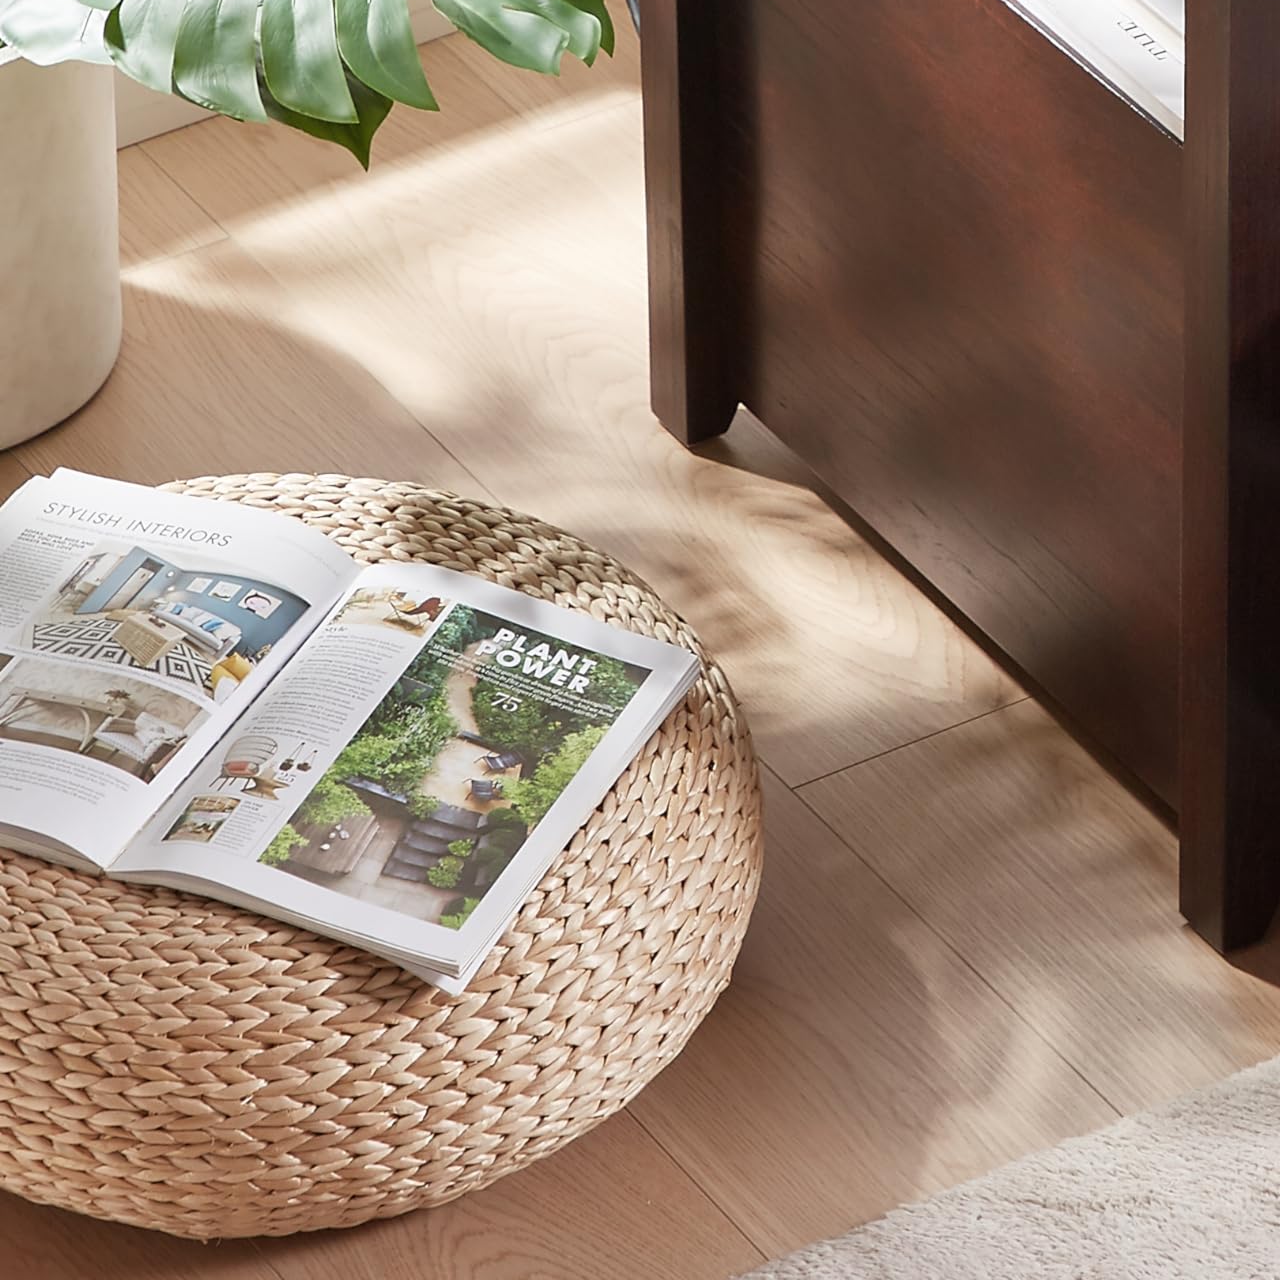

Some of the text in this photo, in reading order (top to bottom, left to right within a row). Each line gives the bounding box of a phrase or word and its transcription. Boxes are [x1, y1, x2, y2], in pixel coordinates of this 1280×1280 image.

[43, 502, 123, 527] STYLISH
[126, 519, 232, 548] INTERIORS
[475, 640, 590, 694] POWER
[493, 628, 597, 675] PLANT
[491, 692, 523, 713] 75
